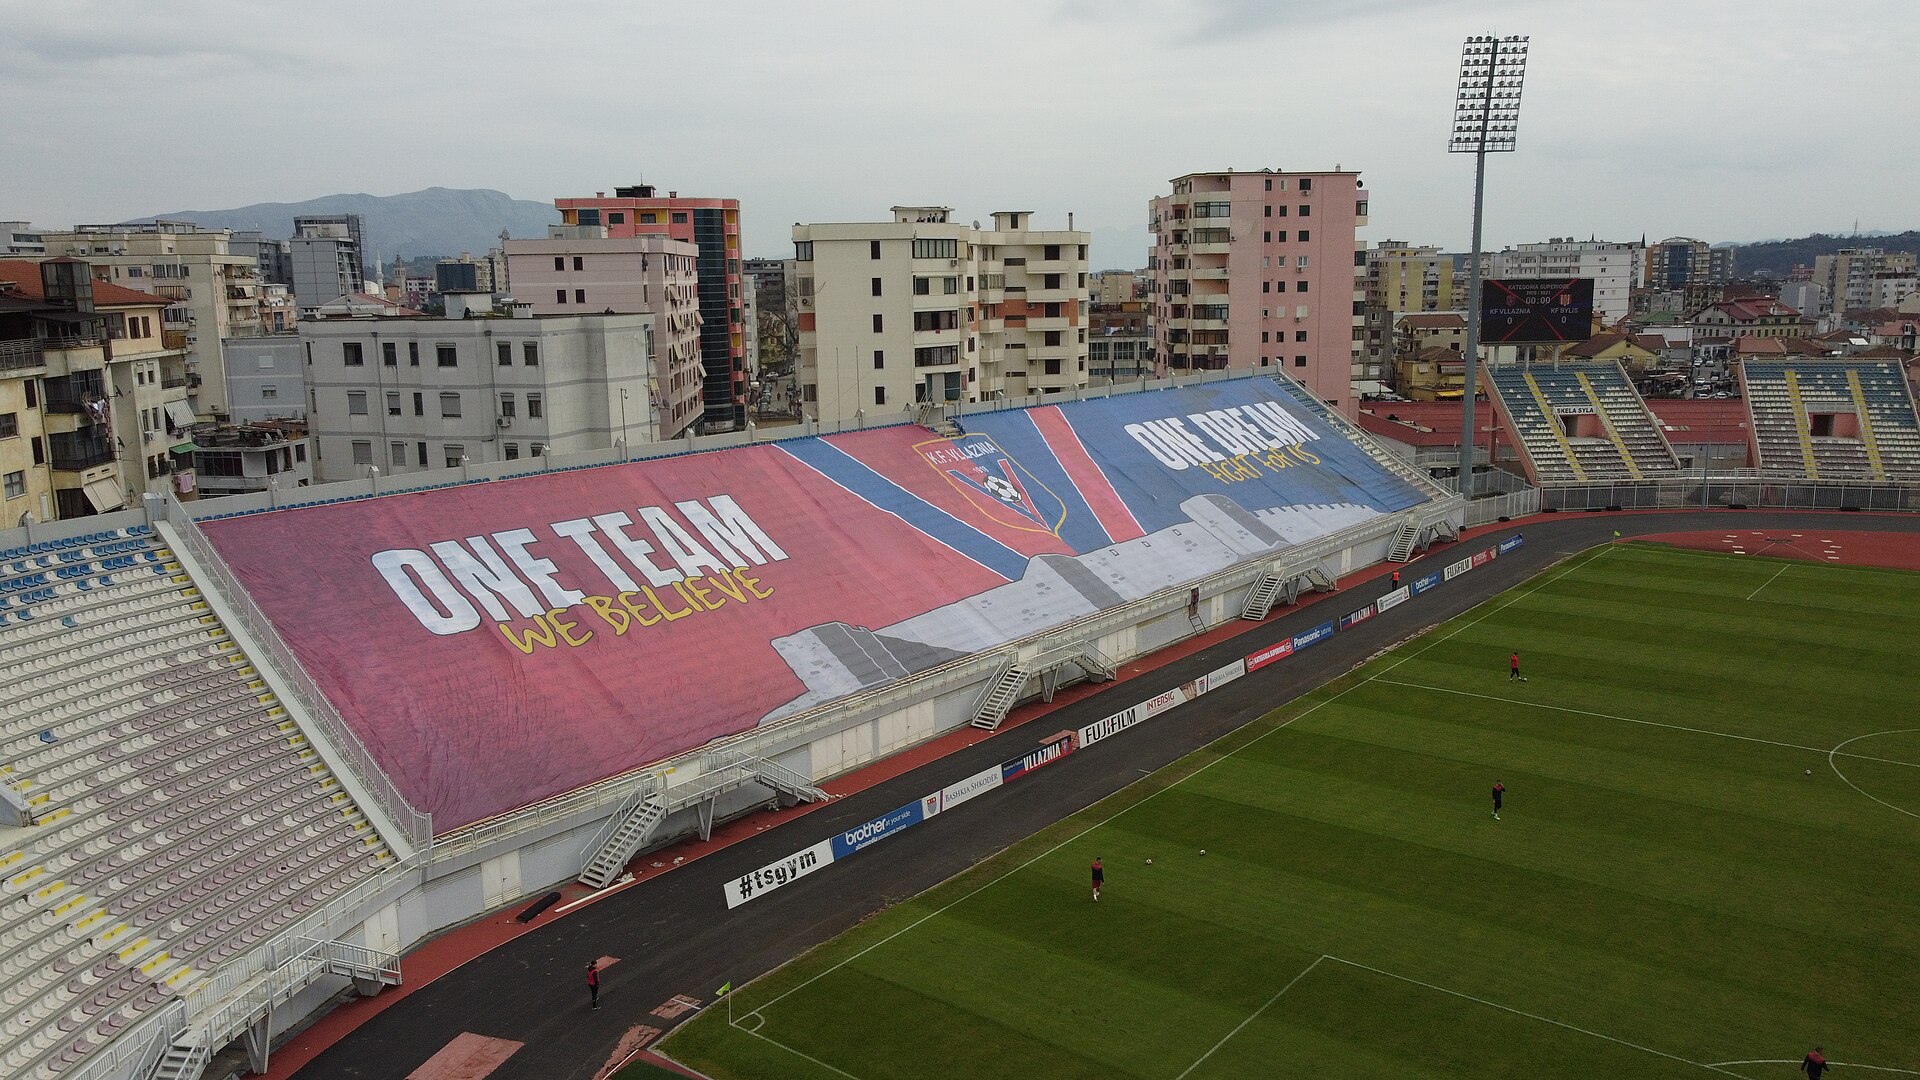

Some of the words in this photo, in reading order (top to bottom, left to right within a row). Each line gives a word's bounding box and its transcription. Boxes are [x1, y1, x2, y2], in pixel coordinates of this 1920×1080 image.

[1525, 296, 1551, 305] 00:00
[1507, 316, 1513, 325] 0
[1561, 315, 1567, 324] 0
[1124, 417, 1227, 471] ONE
[1186, 401, 1321, 456] DREAM
[945, 441, 1000, 462] VLLAZNIA
[1199, 453, 1263, 485] FIGHT
[371, 527, 587, 636] ONE
[549, 494, 790, 592] TEAM
[1446, 558, 1471, 579] FUJIFILM
[498, 608, 594, 654] WE
[581, 565, 775, 636] BELIEVE
[1293, 628, 1321, 648] Panasonic
[1146, 691, 1175, 711] INTERSIG
[1085, 708, 1137, 744] FUJIFILM
[1023, 742, 1061, 771] VLLAZNIA
[945, 785, 970, 803] BASHKIA
[845, 818, 887, 846] brother
[890, 816, 902, 826] your
[901, 810, 911, 820] side
[739, 850, 817, 899] #tsgym
